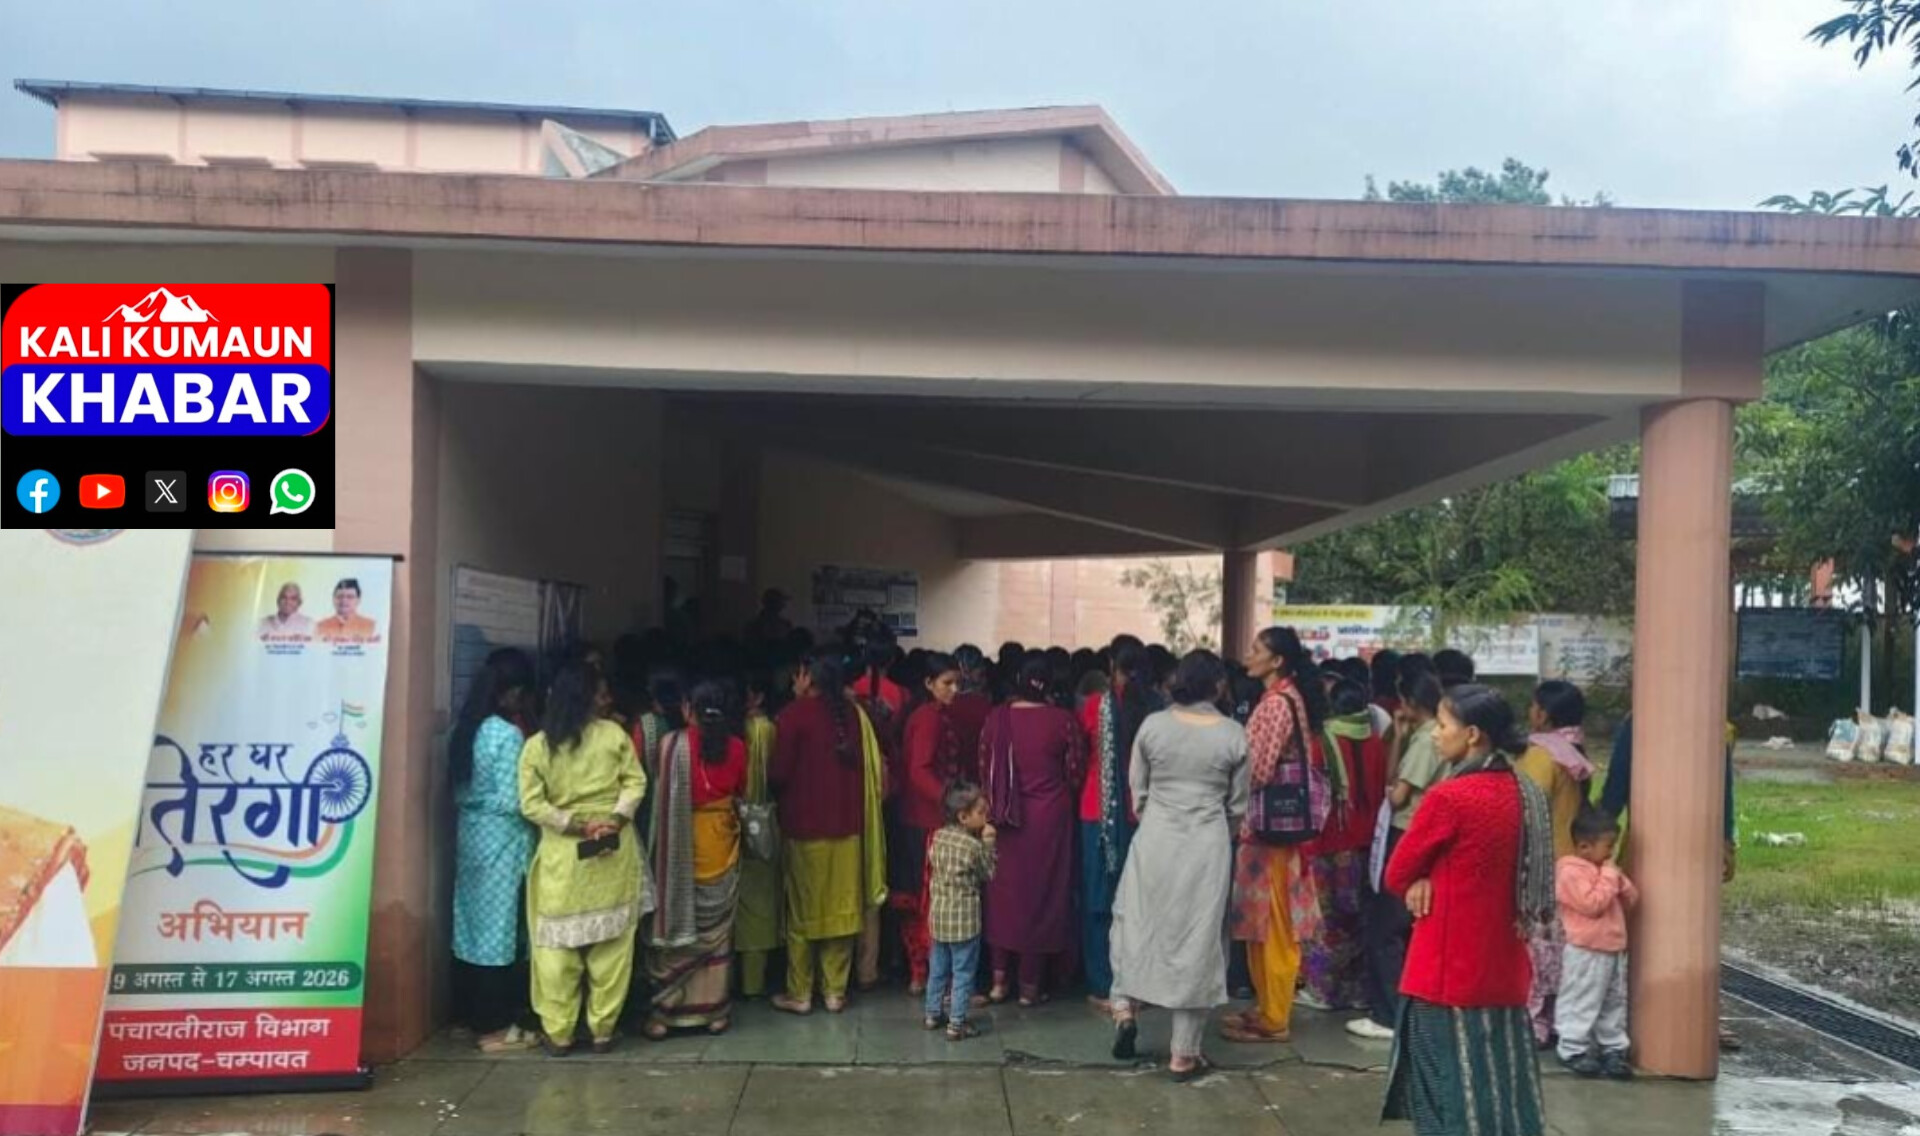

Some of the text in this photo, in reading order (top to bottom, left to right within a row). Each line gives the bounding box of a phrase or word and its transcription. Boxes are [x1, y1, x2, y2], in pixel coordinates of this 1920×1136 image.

[198, 743, 294, 783] हर घर
[157, 898, 310, 942] अभियान
[112, 965, 350, 990] 9 अगस्त से 17 अगस्त 2026
[108, 1013, 331, 1041] पंचायतीराज विभाग
